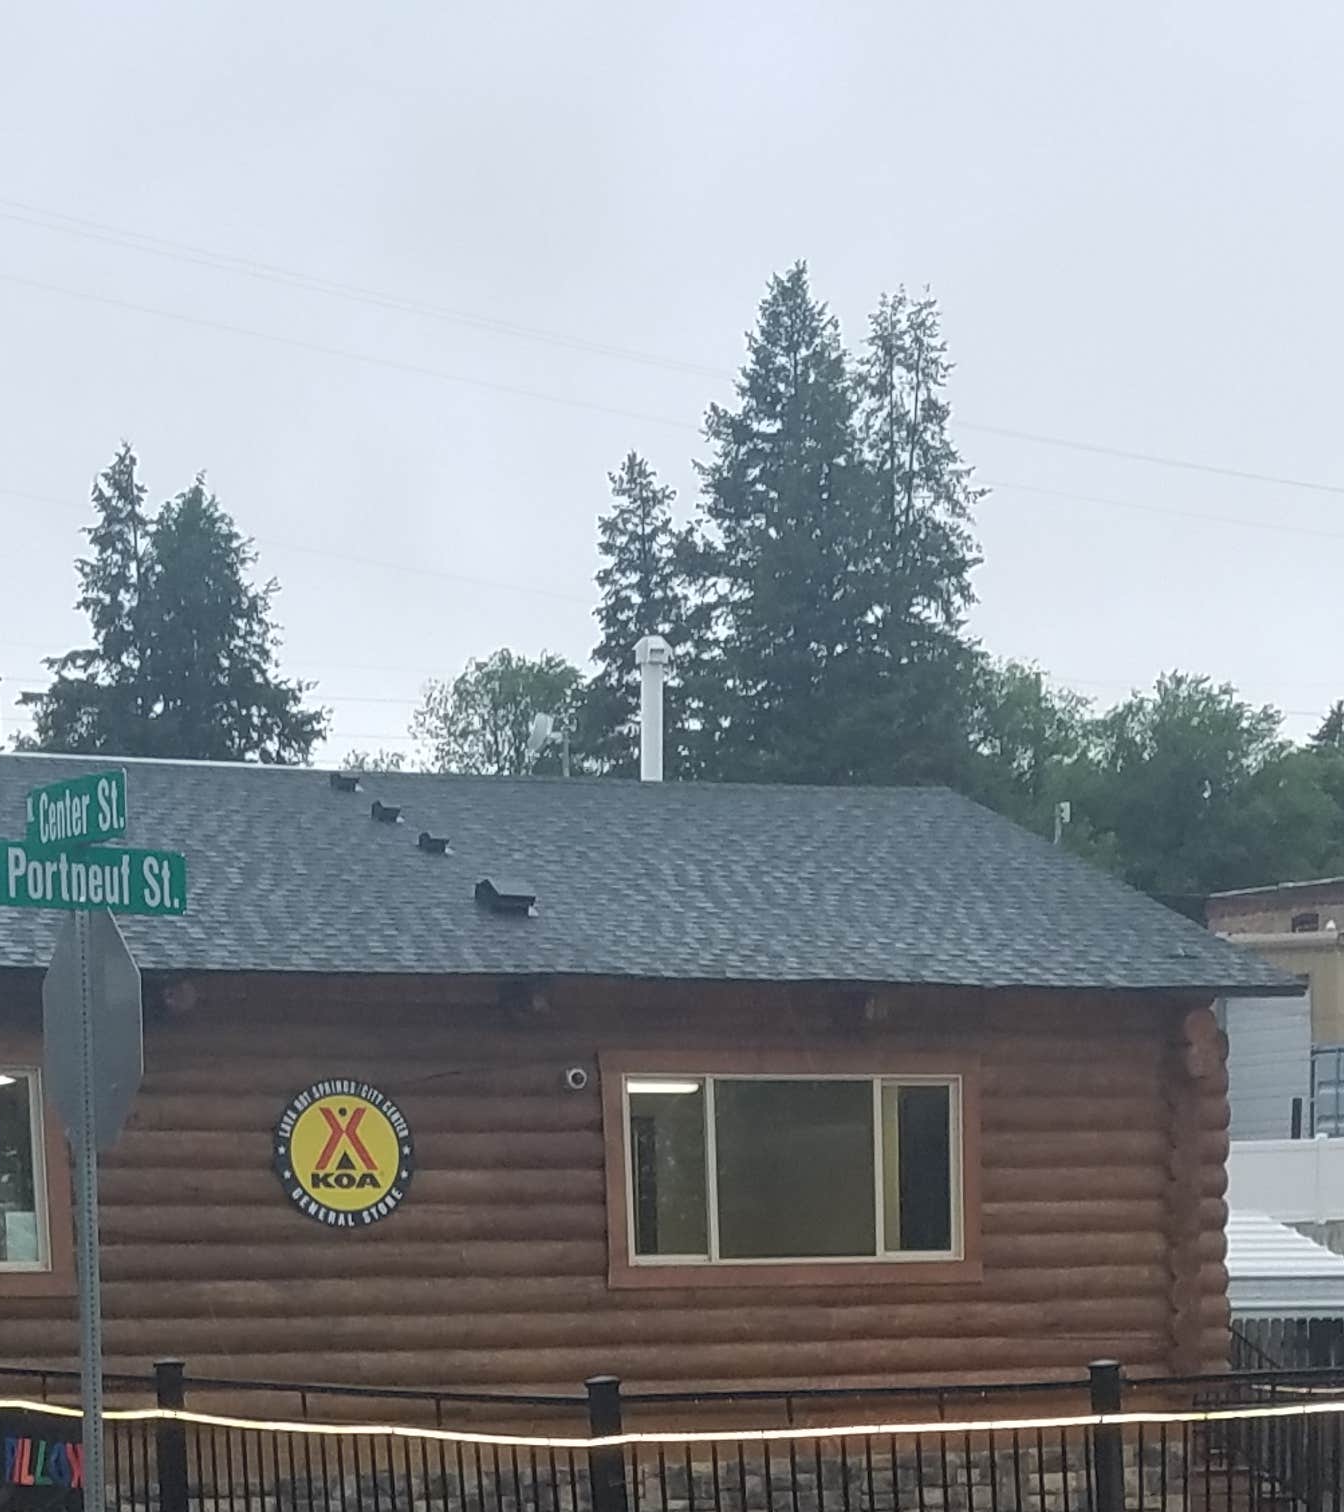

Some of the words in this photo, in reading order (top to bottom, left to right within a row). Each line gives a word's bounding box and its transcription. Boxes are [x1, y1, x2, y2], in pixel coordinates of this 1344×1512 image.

[39, 789, 90, 844] Center
[97, 777, 125, 831] St.
[8, 846, 130, 905] Portneuf
[143, 855, 180, 909] St.
[381, 1101, 409, 1139] CENTER
[311, 1172, 381, 1189] KOA
[291, 1187, 355, 1227] GENERAL
[361, 1187, 403, 1224] STORE
